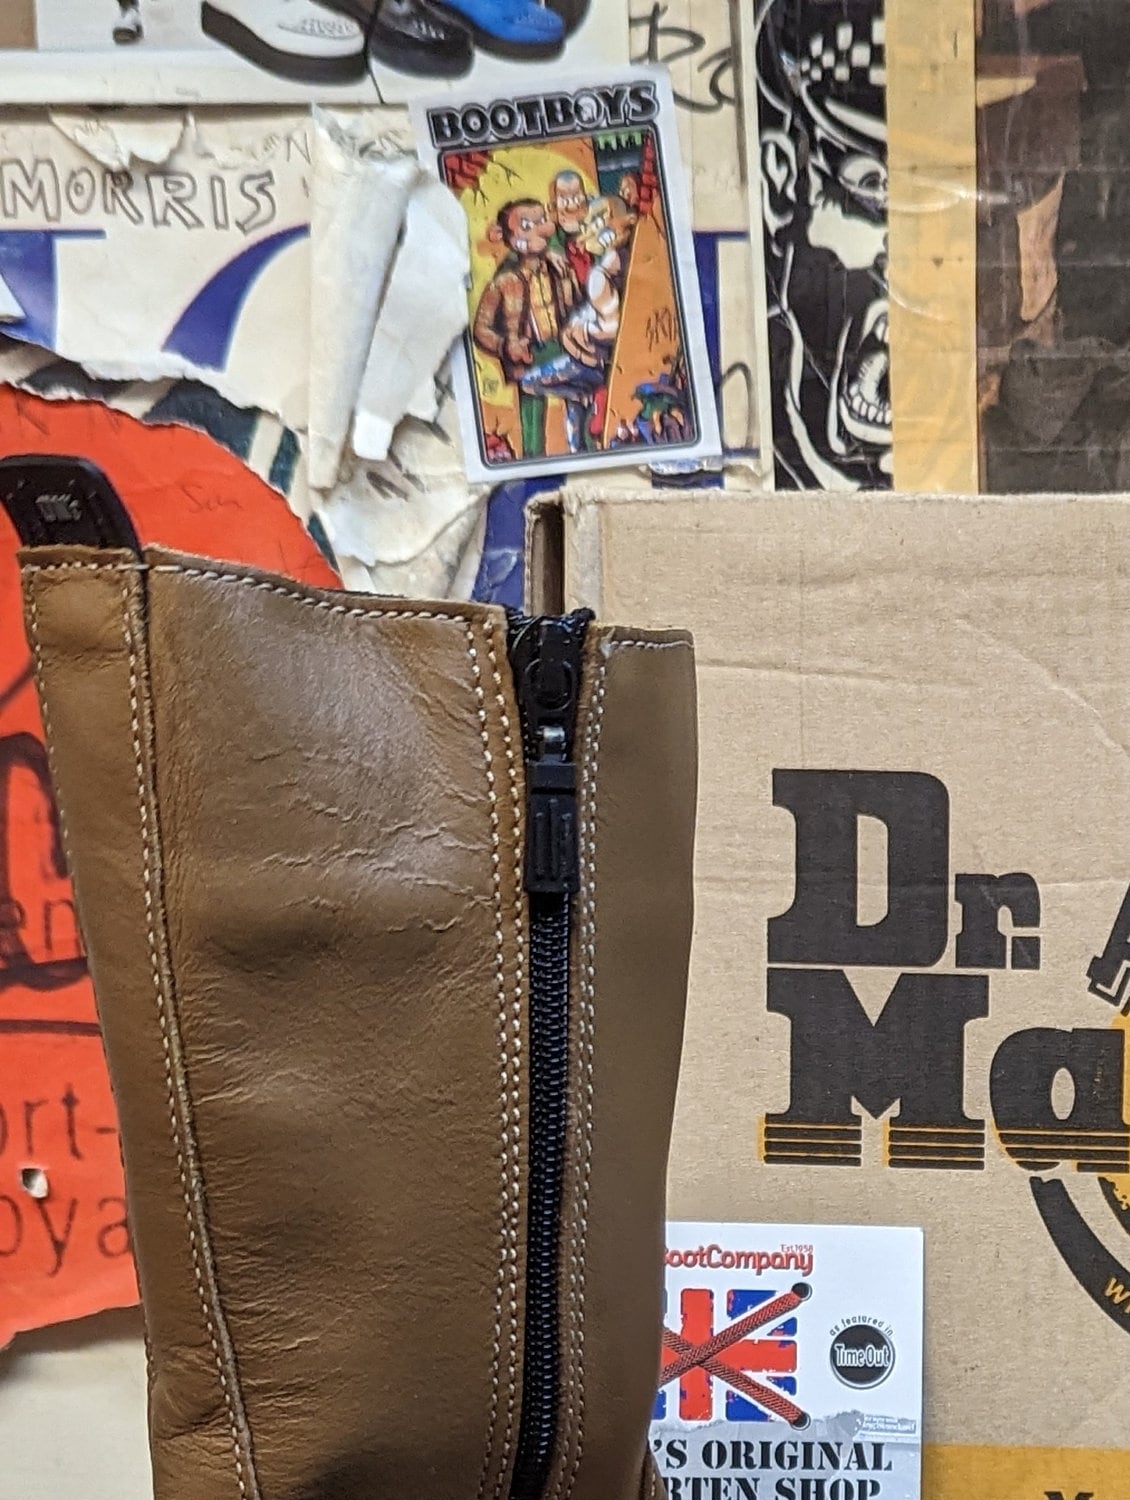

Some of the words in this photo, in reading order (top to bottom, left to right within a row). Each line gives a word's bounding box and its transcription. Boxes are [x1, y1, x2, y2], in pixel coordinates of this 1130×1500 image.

[2, 157, 277, 234] MORRIS
[767, 768, 1041, 970] Dr.
[664, 1244, 814, 1277] ootCompany
[701, 1439, 893, 1472] ORIGINAL
